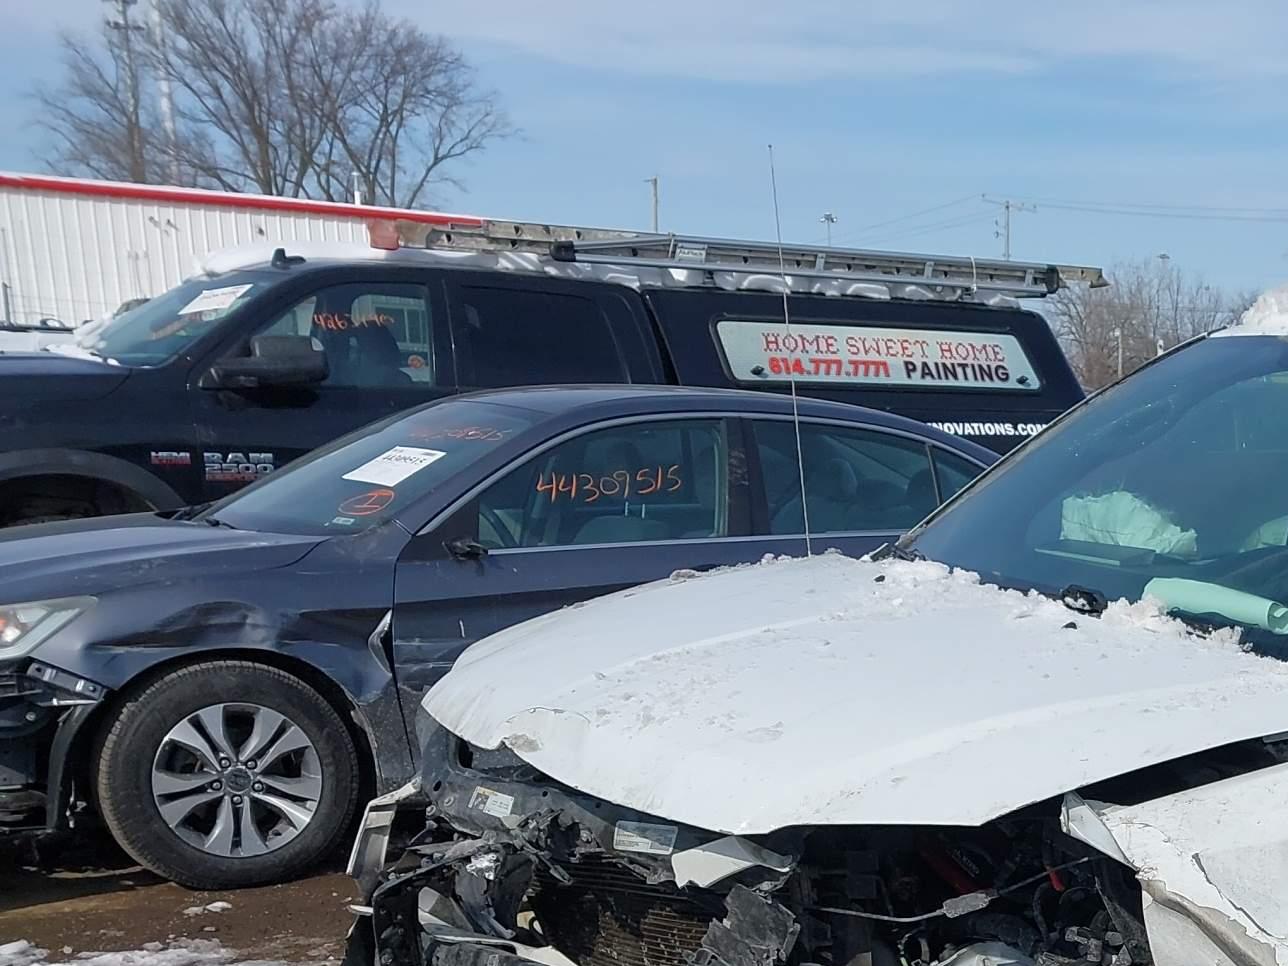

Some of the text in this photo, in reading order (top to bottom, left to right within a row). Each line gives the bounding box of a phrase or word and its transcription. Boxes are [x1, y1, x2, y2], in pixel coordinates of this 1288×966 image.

[762, 332, 1006, 363] HOME SWEET HOME
[903, 360, 1010, 383] PAINTING
[203, 452, 273, 464] RAM
[204, 463, 274, 474] 2500
[535, 464, 682, 503] 44309515
